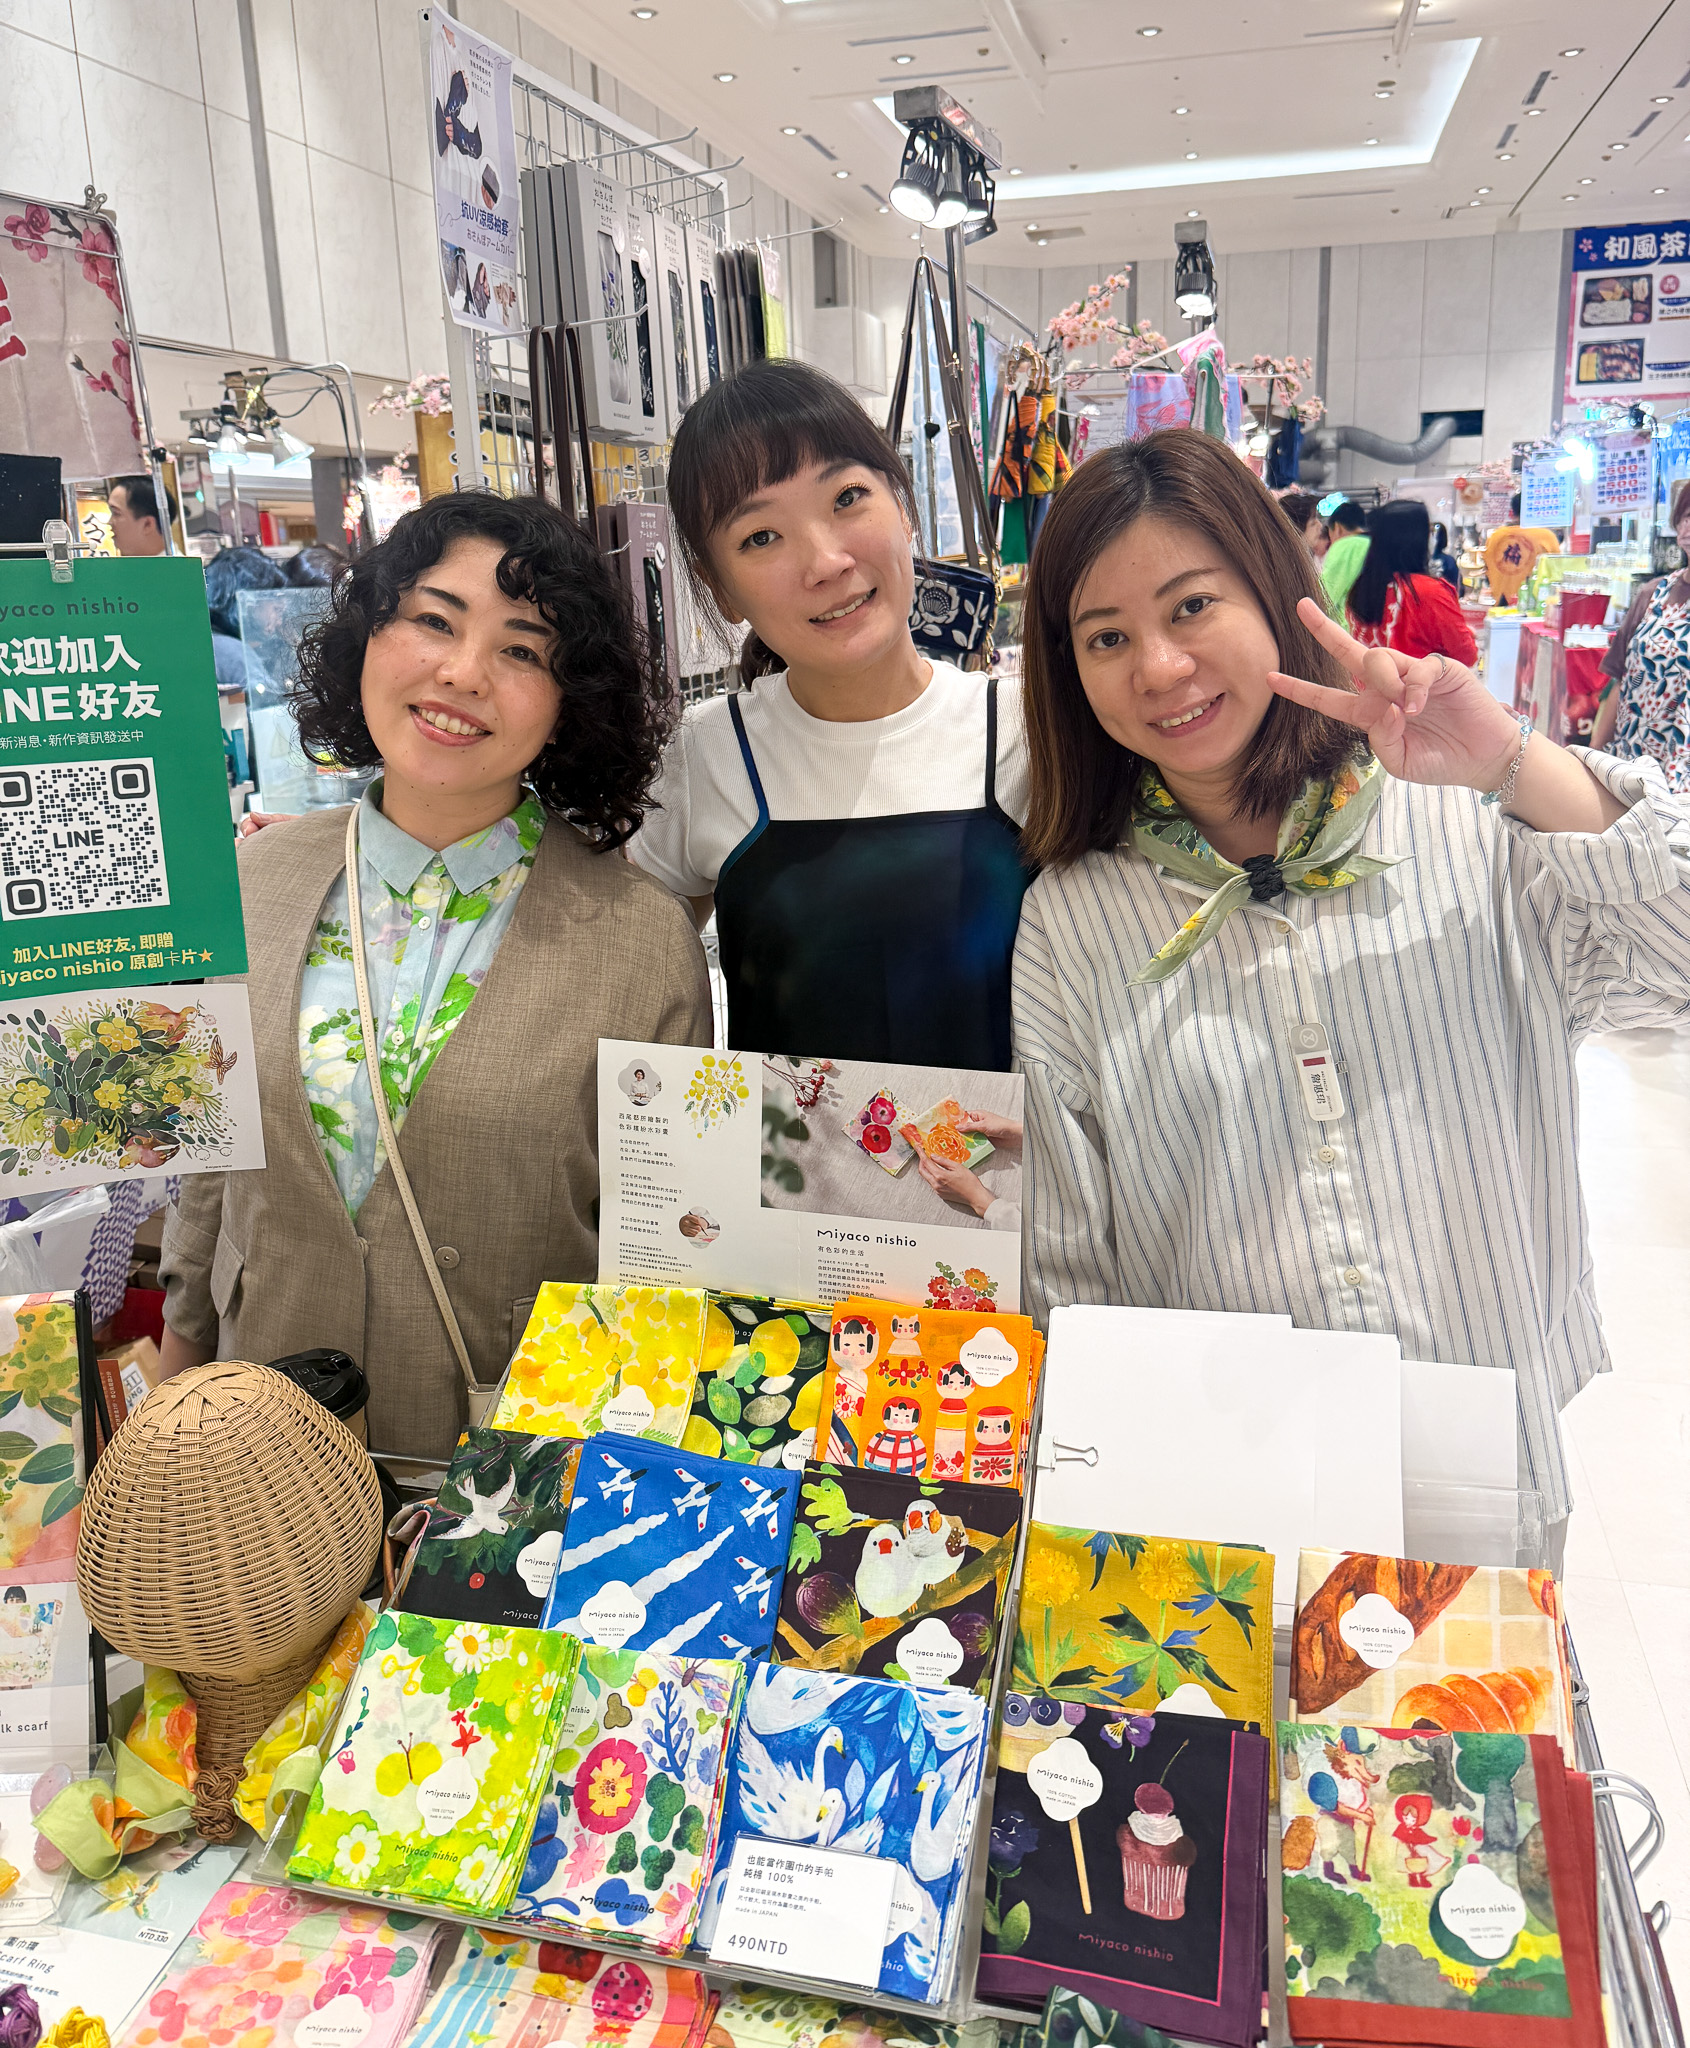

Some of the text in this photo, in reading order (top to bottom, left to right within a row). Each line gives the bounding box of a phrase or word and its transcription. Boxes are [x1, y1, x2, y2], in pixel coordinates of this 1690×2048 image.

[461, 200, 509, 236] 抗UV涼感袖套
[467, 228, 514, 256] おさんぽアームカバー
[1604, 230, 1690, 262] 和風茶
[67, 596, 139, 616] nishio
[0, 686, 74, 723] NE
[53, 829, 105, 849] LINE
[0, 967, 57, 986] iyaco
[63, 958, 124, 976] nishio
[876, 1234, 917, 1247] nishio
[818, 1246, 864, 1256] 有色彩的生活
[993, 1354, 1012, 1362] nishio
[1382, 1626, 1406, 1635] nishio
[936, 1652, 958, 1660] nishio
[570, 1706, 590, 1714] nishio
[18, 1720, 48, 1732] scarf
[1070, 1776, 1094, 1788] nishio
[452, 1792, 470, 1800] nishio
[432, 1850, 458, 1863] nishio
[747, 1855, 834, 1878] 也能當作圍巾的手帕
[744, 1868, 794, 1884] 純棉 100%
[624, 1901, 655, 1914] nishio
[890, 1900, 914, 1912] nishio
[1489, 1904, 1516, 1912] nishio
[154, 1934, 168, 1942] 330
[728, 1934, 788, 1955] 490NTD
[1134, 1944, 1174, 1962] nishio
[28, 1958, 55, 1974] Ring
